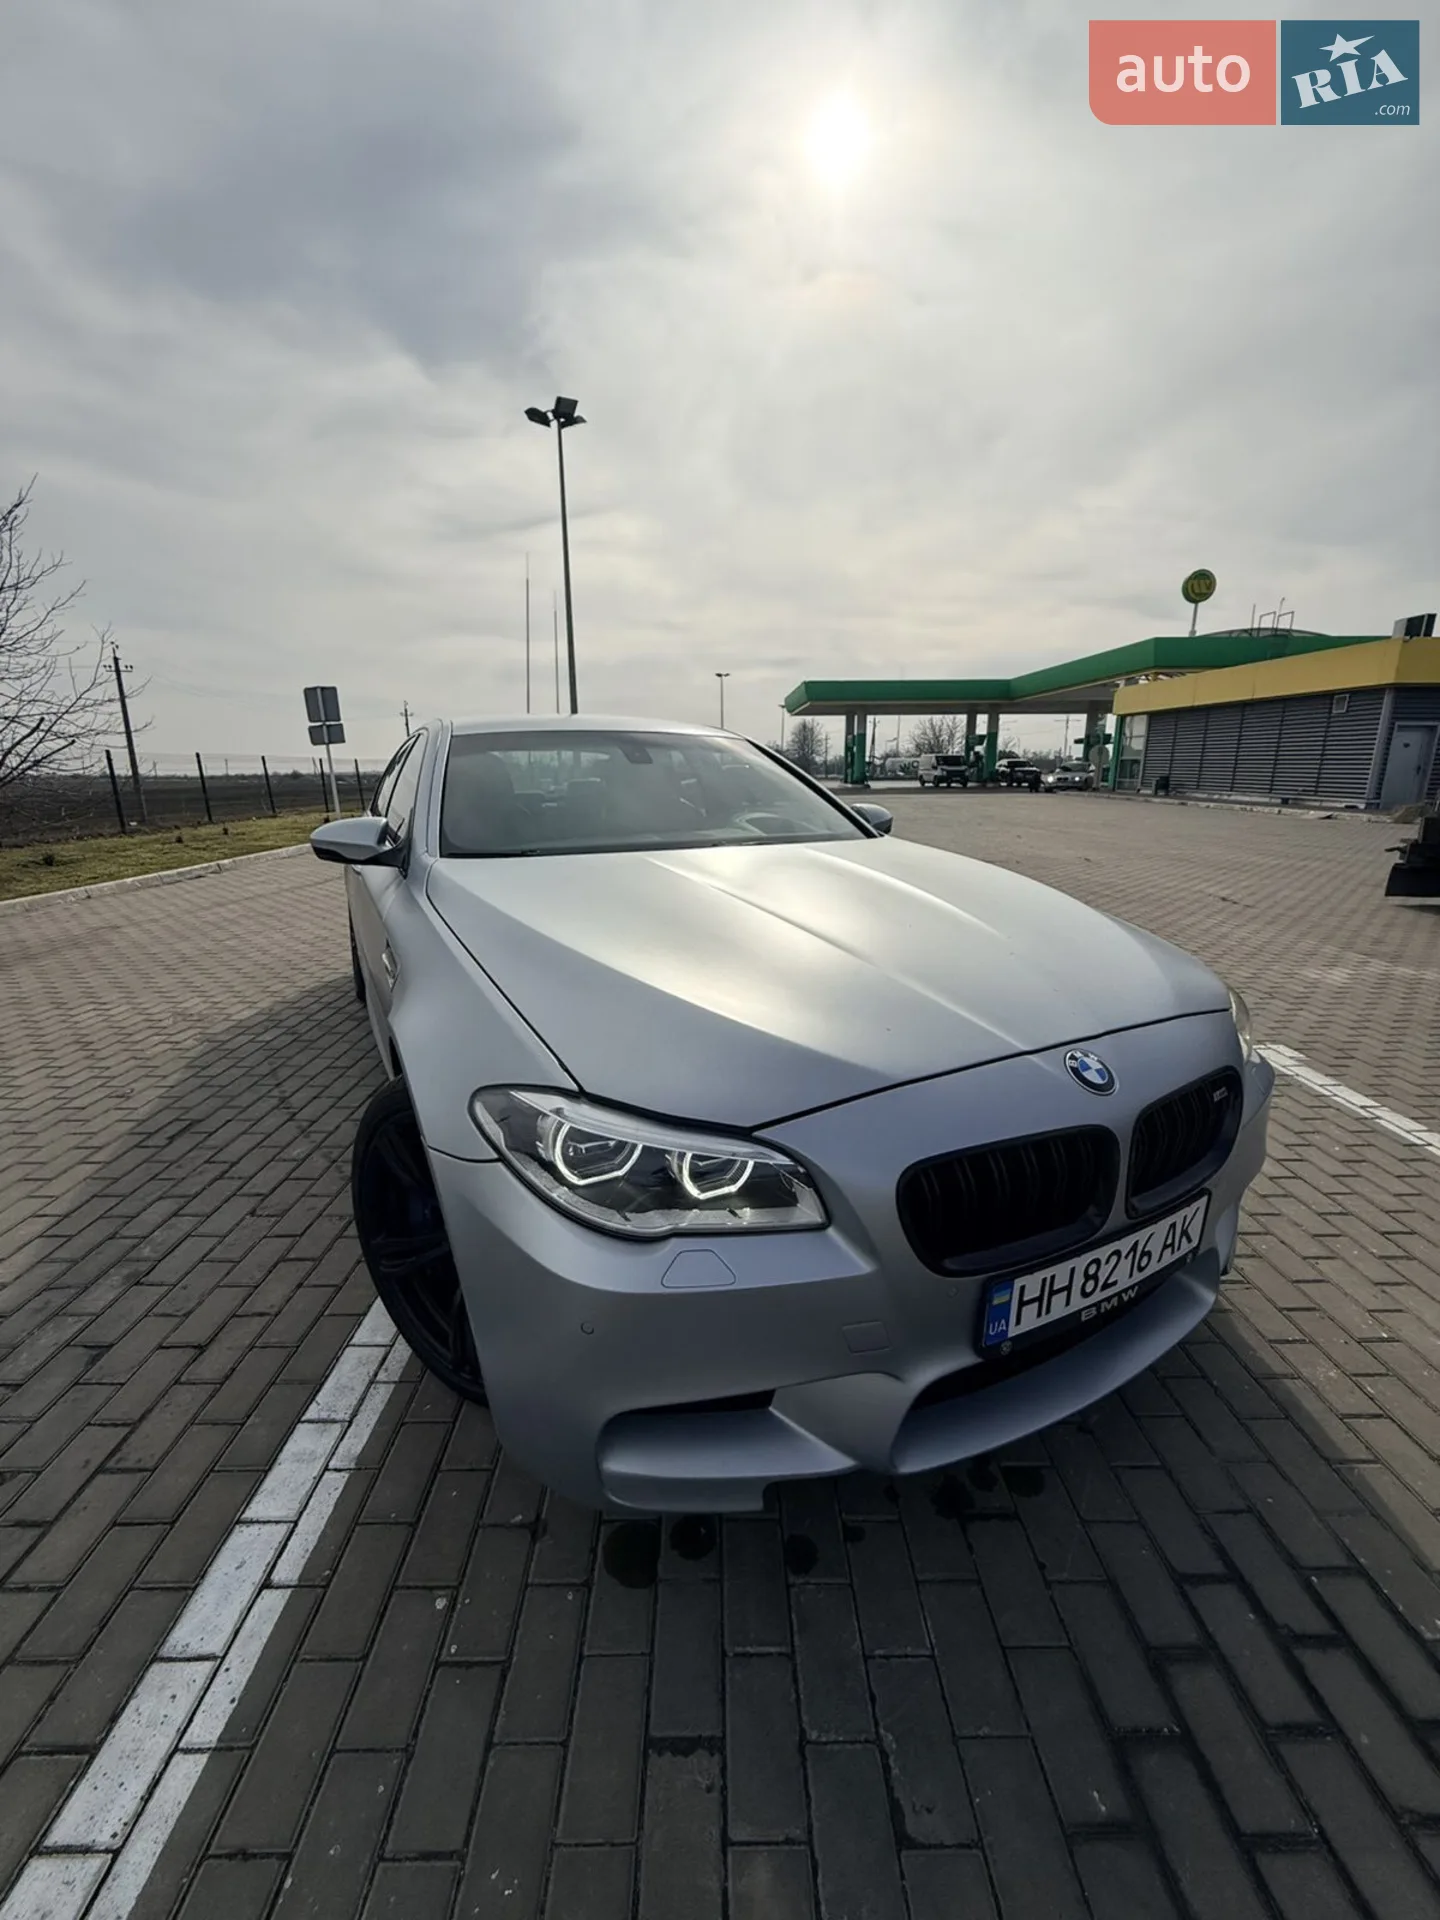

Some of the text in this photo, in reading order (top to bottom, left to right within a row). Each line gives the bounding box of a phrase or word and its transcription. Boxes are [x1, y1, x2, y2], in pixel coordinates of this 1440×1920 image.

[1015, 1206, 1201, 1327] HH 8216 AK
[1080, 1285, 1140, 1322] BMW
[989, 1319, 1007, 1336] UA
